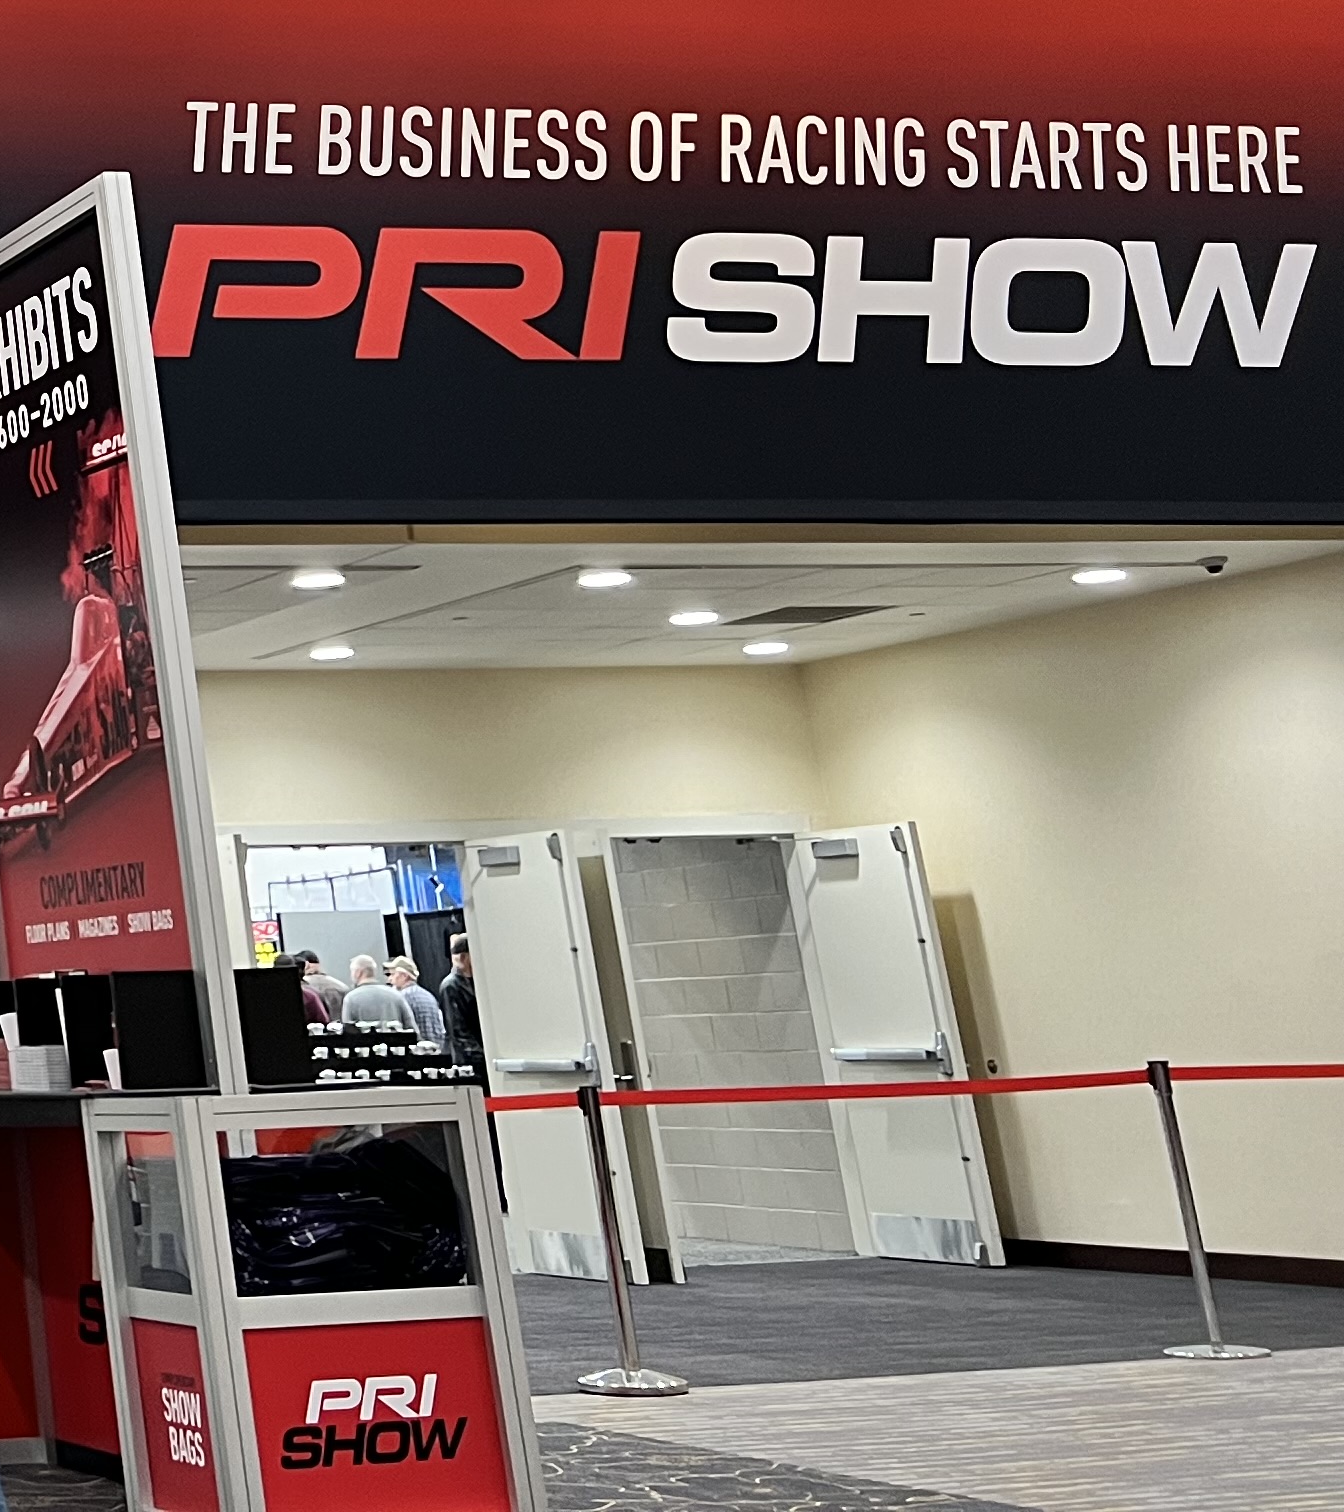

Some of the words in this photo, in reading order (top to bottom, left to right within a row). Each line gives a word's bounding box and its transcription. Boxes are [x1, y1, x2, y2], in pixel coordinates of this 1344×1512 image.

[186, 100, 297, 176] THE
[317, 103, 608, 182] BUSINESS
[629, 110, 699, 183] OF
[719, 113, 927, 188] RACING
[946, 118, 1149, 192] STARTS
[1167, 123, 1304, 195] HERE
[151, 223, 641, 361] PRI
[666, 231, 1318, 369] SHOW
[39, 860, 146, 911] COMPLIMENTARY
[47, 921, 71, 942] PLANS
[78, 915, 120, 938] MAGAZINES
[127, 911, 152, 934] SHOW
[152, 908, 174, 931] BAGS
[161, 1387, 202, 1429] SHOW
[305, 1373, 438, 1425] PRI
[168, 1425, 206, 1468] BAGS
[280, 1416, 469, 1470] SHOW
